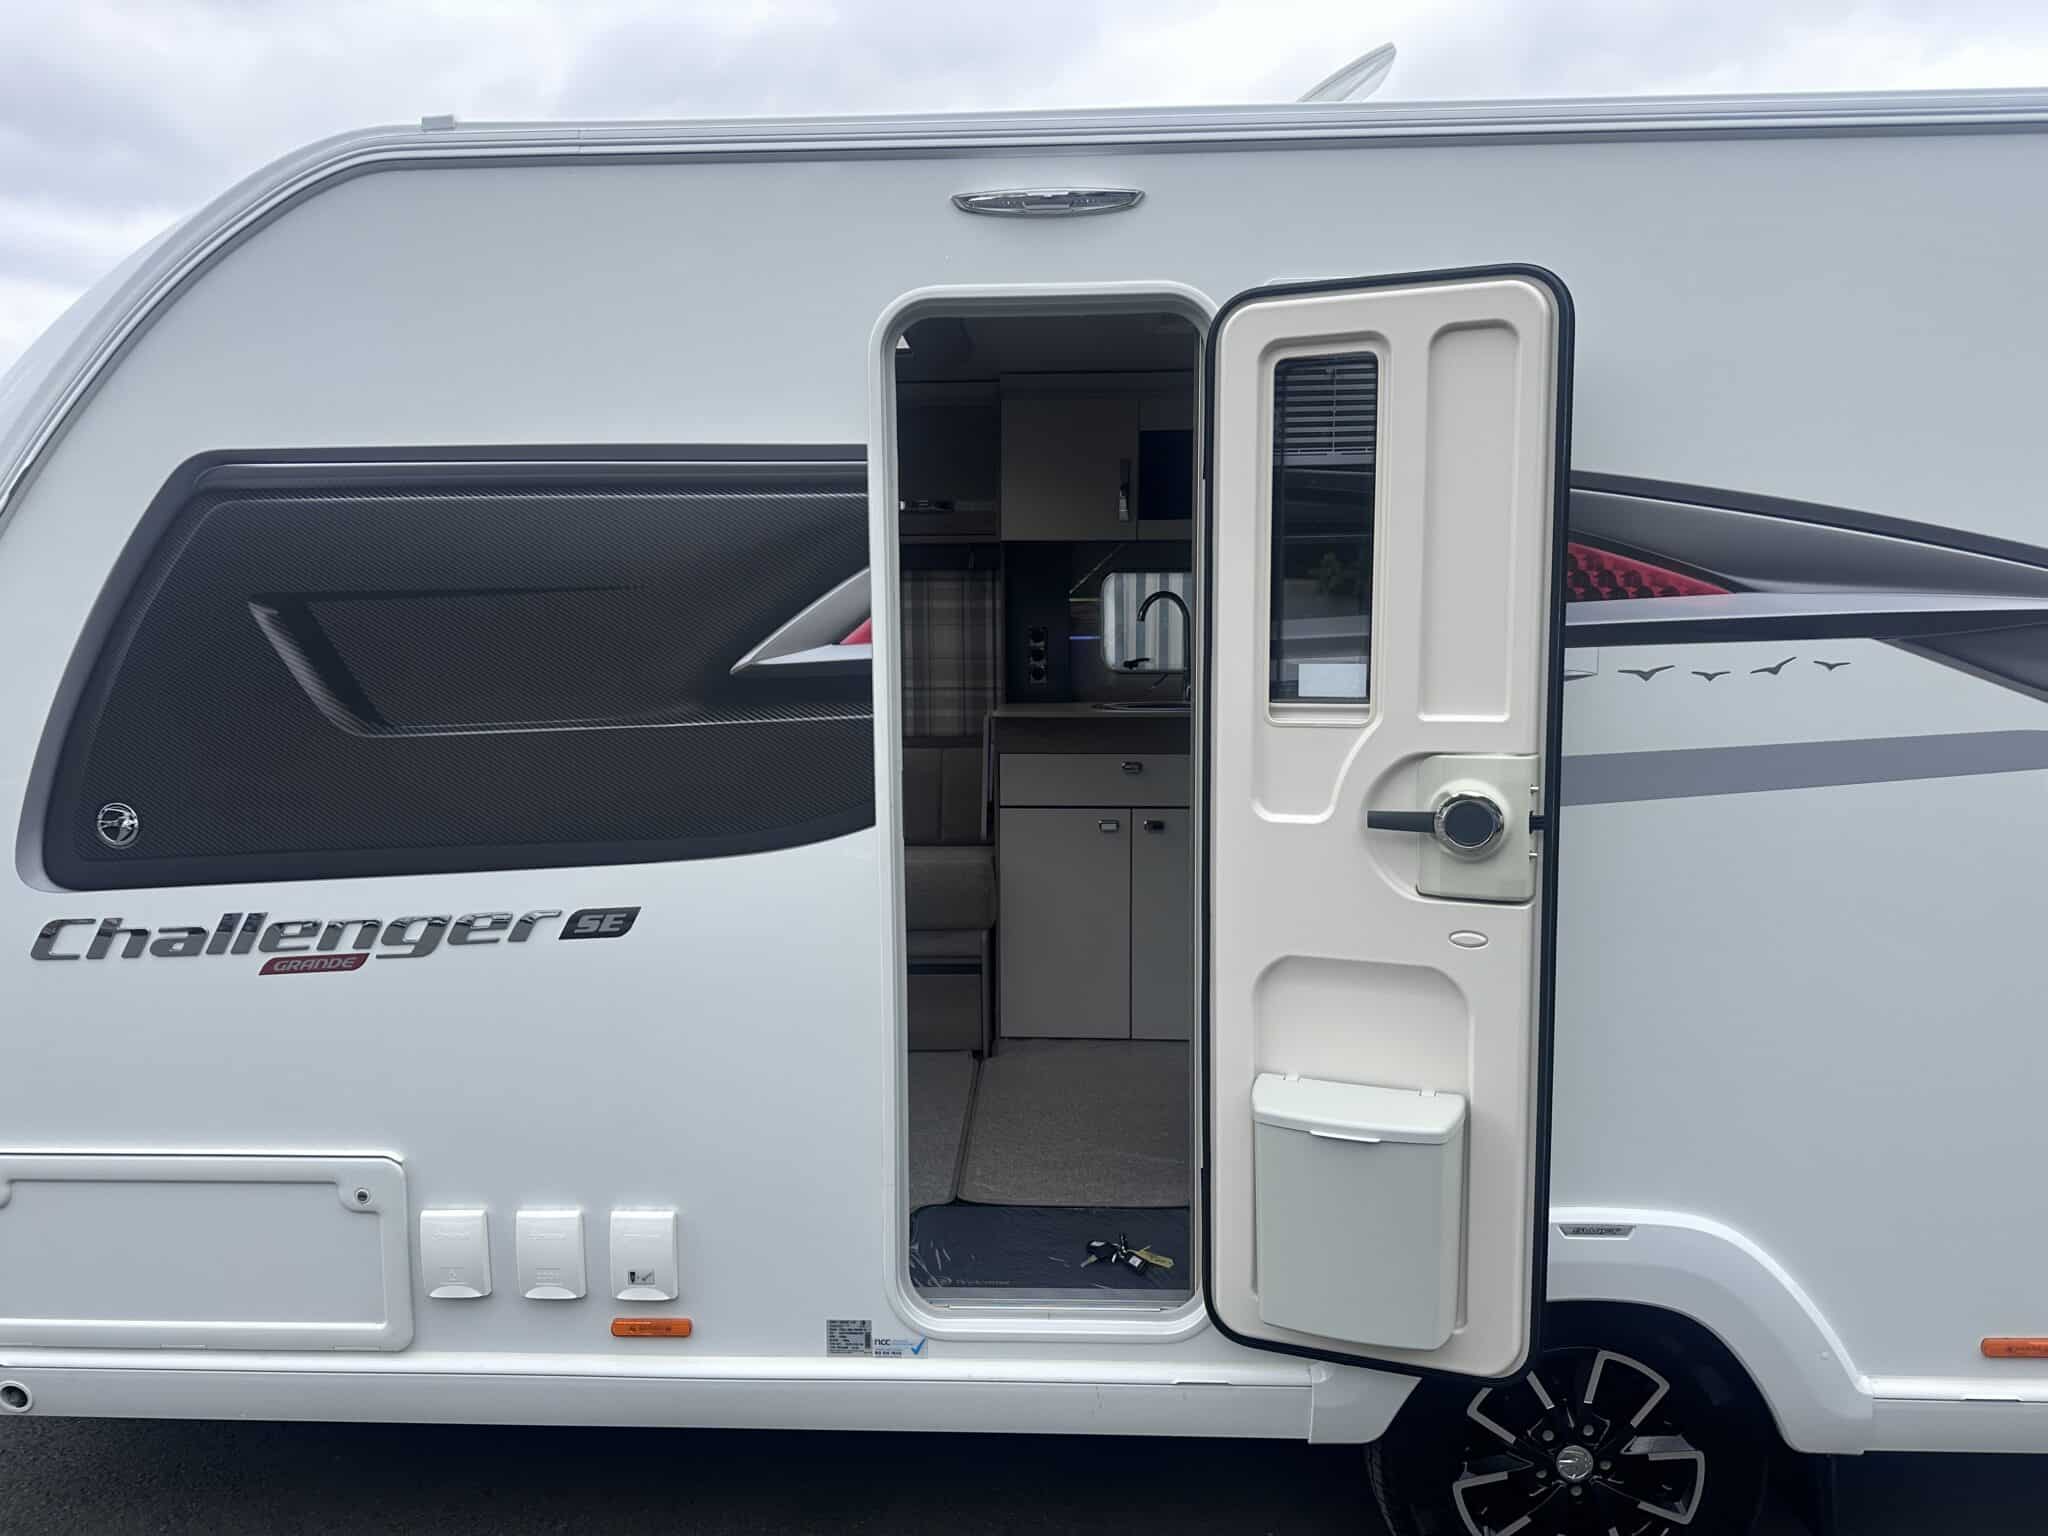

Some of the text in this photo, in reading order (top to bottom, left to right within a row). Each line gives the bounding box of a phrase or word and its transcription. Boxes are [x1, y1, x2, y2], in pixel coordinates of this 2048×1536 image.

[30, 911, 627, 960] Challenger SE
[273, 957, 358, 972] GRANDE
